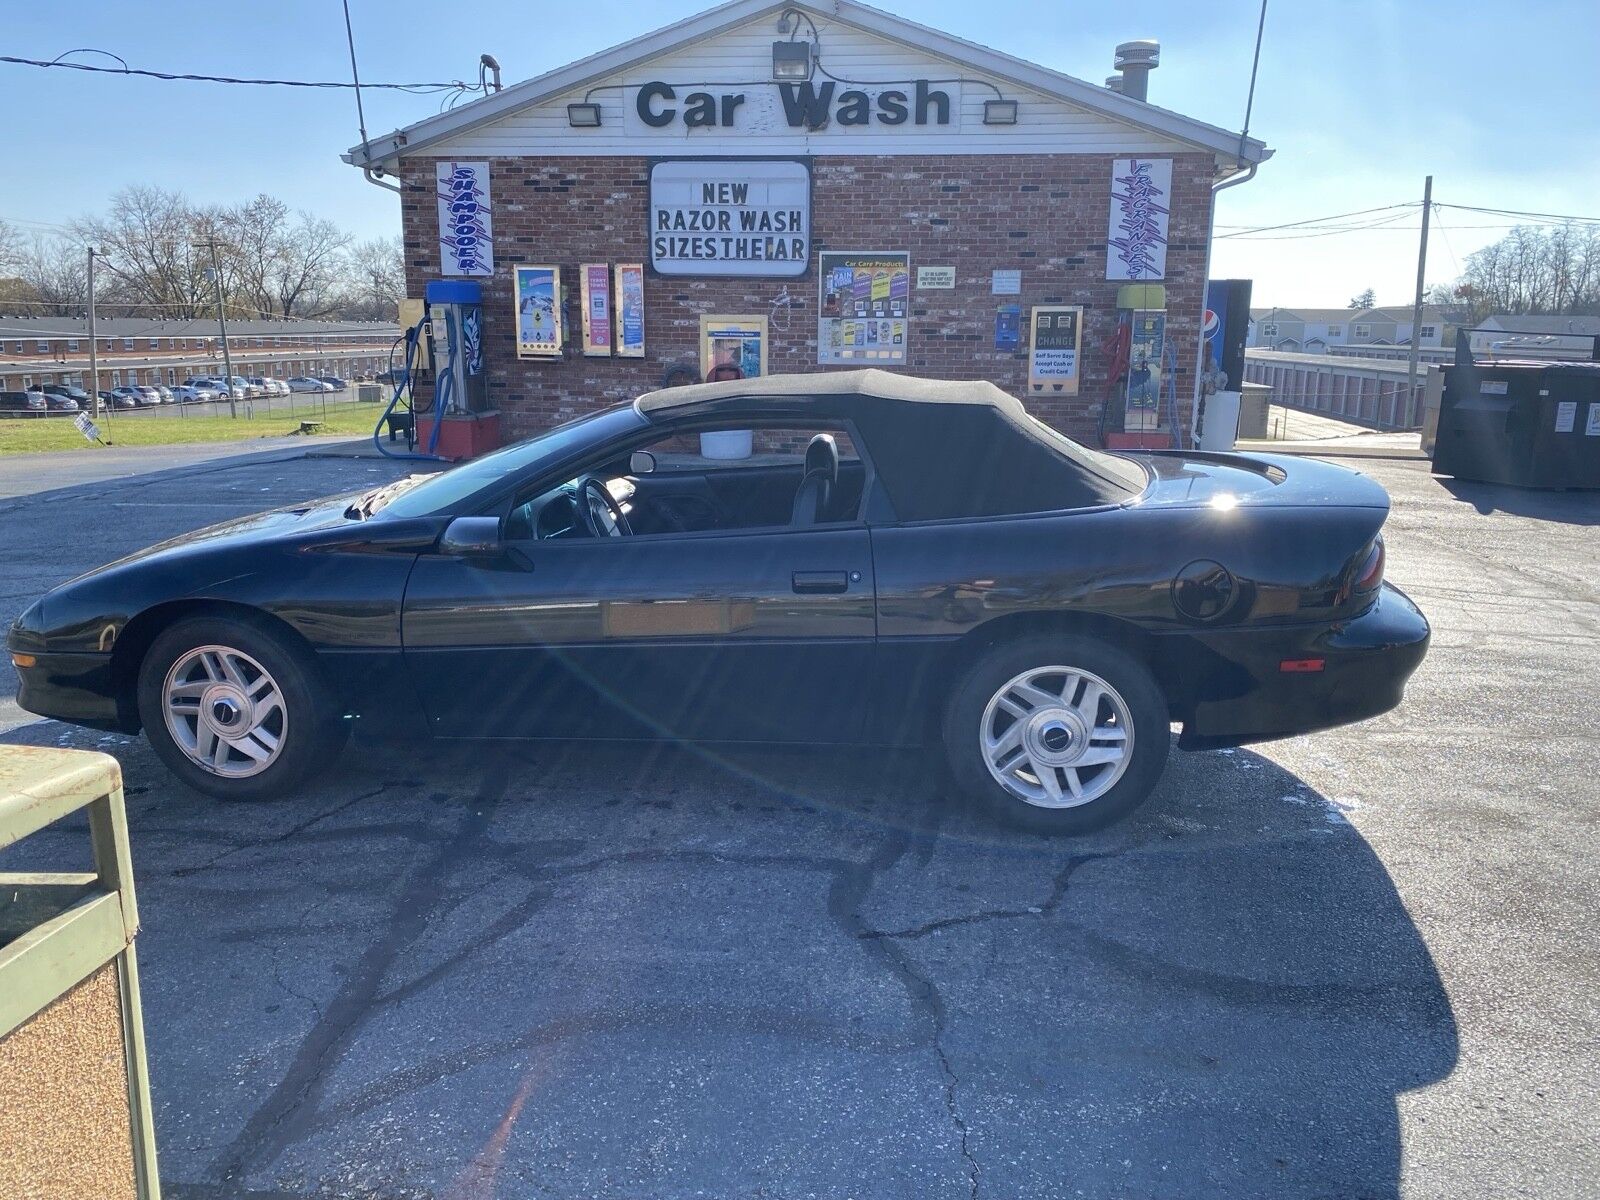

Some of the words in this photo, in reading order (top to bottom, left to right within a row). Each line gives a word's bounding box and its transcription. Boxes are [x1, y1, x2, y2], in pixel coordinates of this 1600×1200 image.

[636, 81, 745, 128] Car
[778, 79, 950, 128] Wash
[702, 183, 748, 204] NEW
[450, 168, 479, 270] SHAMPOOER
[657, 210, 731, 231] RAZOR
[739, 210, 801, 231] WASH
[1126, 163, 1153, 276] FRAGRANCES
[654, 237, 717, 258] SIZES
[721, 237, 763, 259] THE
[1038, 336, 1074, 346] CHANGE
